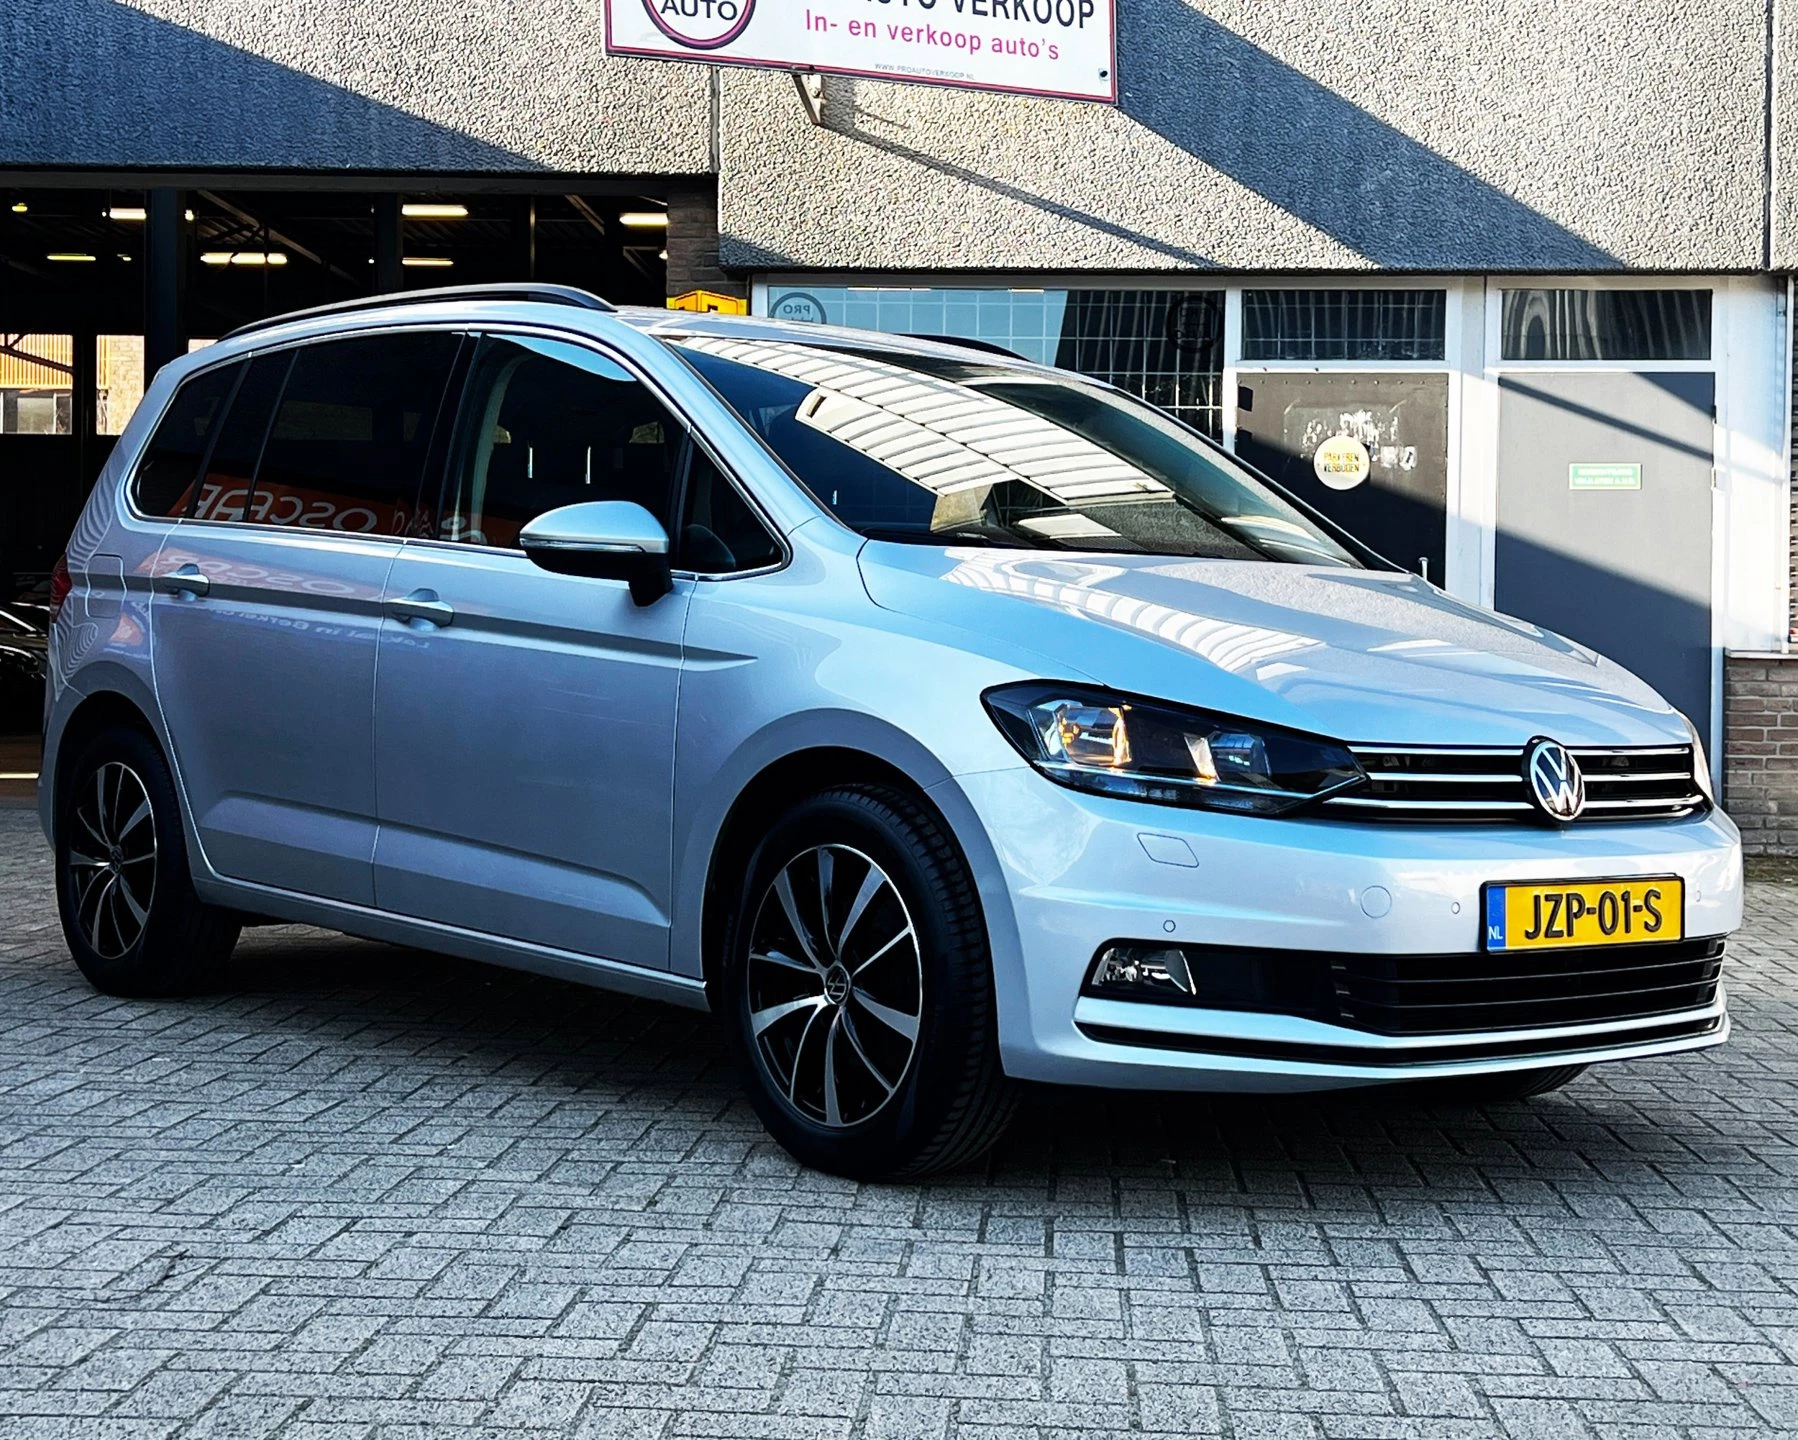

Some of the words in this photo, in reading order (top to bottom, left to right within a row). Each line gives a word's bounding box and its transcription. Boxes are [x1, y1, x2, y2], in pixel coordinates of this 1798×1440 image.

[660, 0, 738, 21] AUTO
[806, 9, 838, 32] In-
[848, 19, 877, 38] en
[887, 23, 982, 55] verkoop
[991, 37, 1059, 60] auto's
[1488, 925, 1504, 940] NL
[1524, 889, 1663, 940] JZP-01-S
